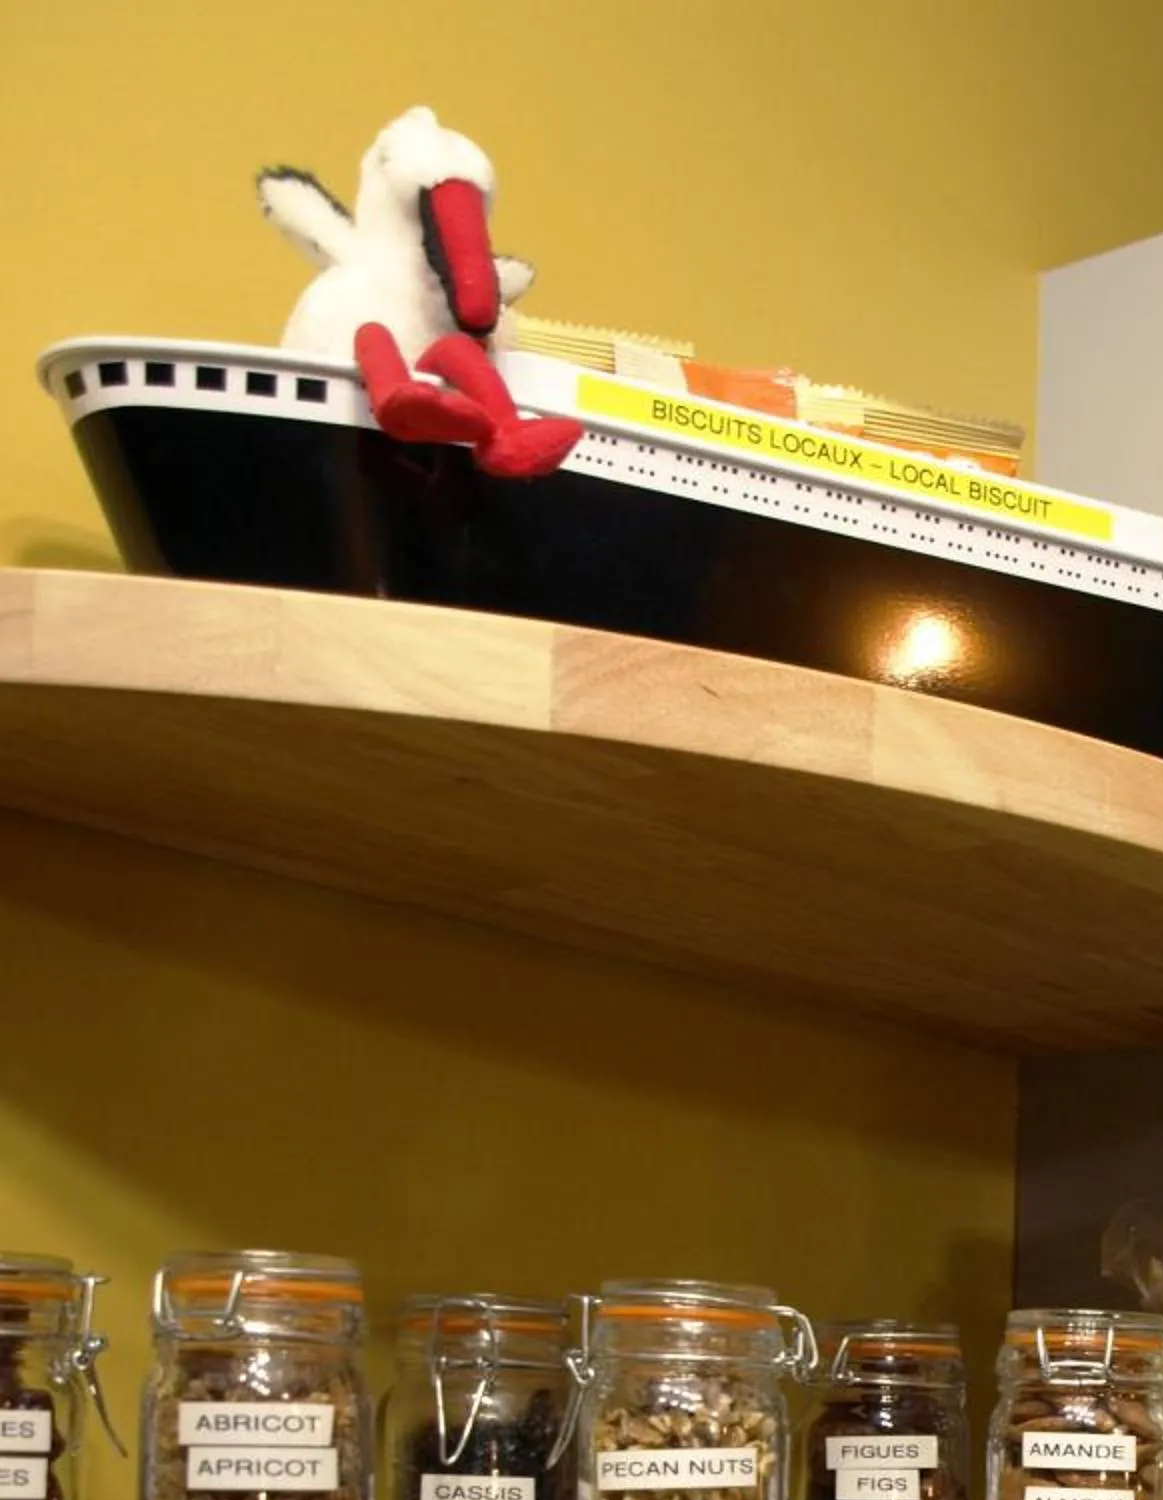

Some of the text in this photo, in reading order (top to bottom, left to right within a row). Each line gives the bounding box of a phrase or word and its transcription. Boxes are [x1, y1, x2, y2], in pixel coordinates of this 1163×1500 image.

[652, 399, 763, 445] BISCUITS
[769, 429, 863, 470] LOCAUX
[890, 460, 961, 496] LOCAL
[967, 481, 1053, 519] BISCUIT
[195, 1414, 321, 1433] ABRICOT
[840, 1443, 920, 1459] FIGUES
[1028, 1441, 1127, 1460] AMANDE
[197, 1459, 322, 1477] APRICOT
[602, 1457, 754, 1478] PECAN NUTS
[857, 1477, 908, 1492] FIGS
